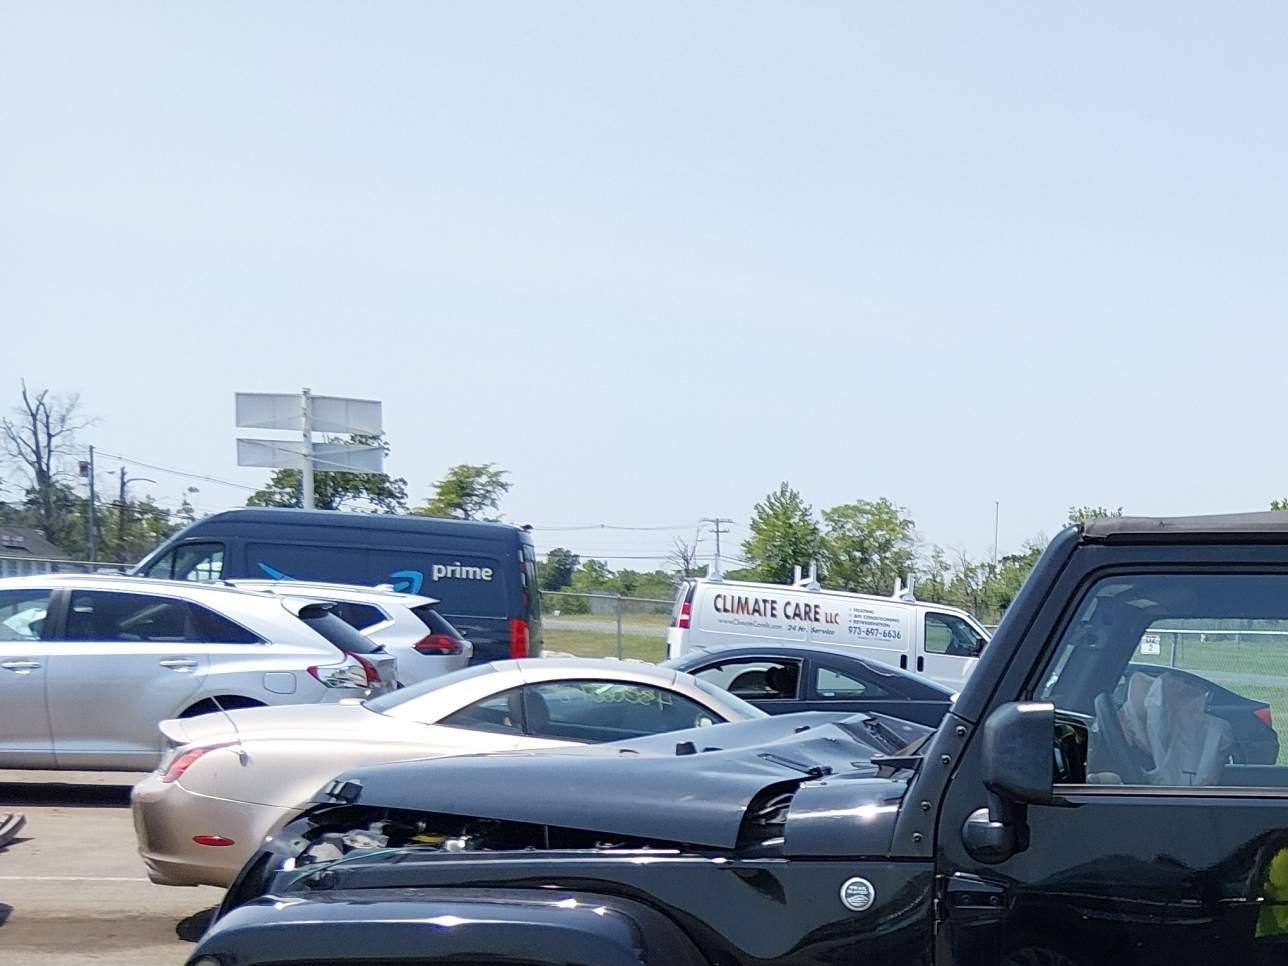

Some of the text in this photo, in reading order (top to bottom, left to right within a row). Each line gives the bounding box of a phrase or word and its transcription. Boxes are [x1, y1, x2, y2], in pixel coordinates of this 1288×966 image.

[432, 561, 493, 581] prime
[714, 594, 840, 625] CLIMATE CARE LLC
